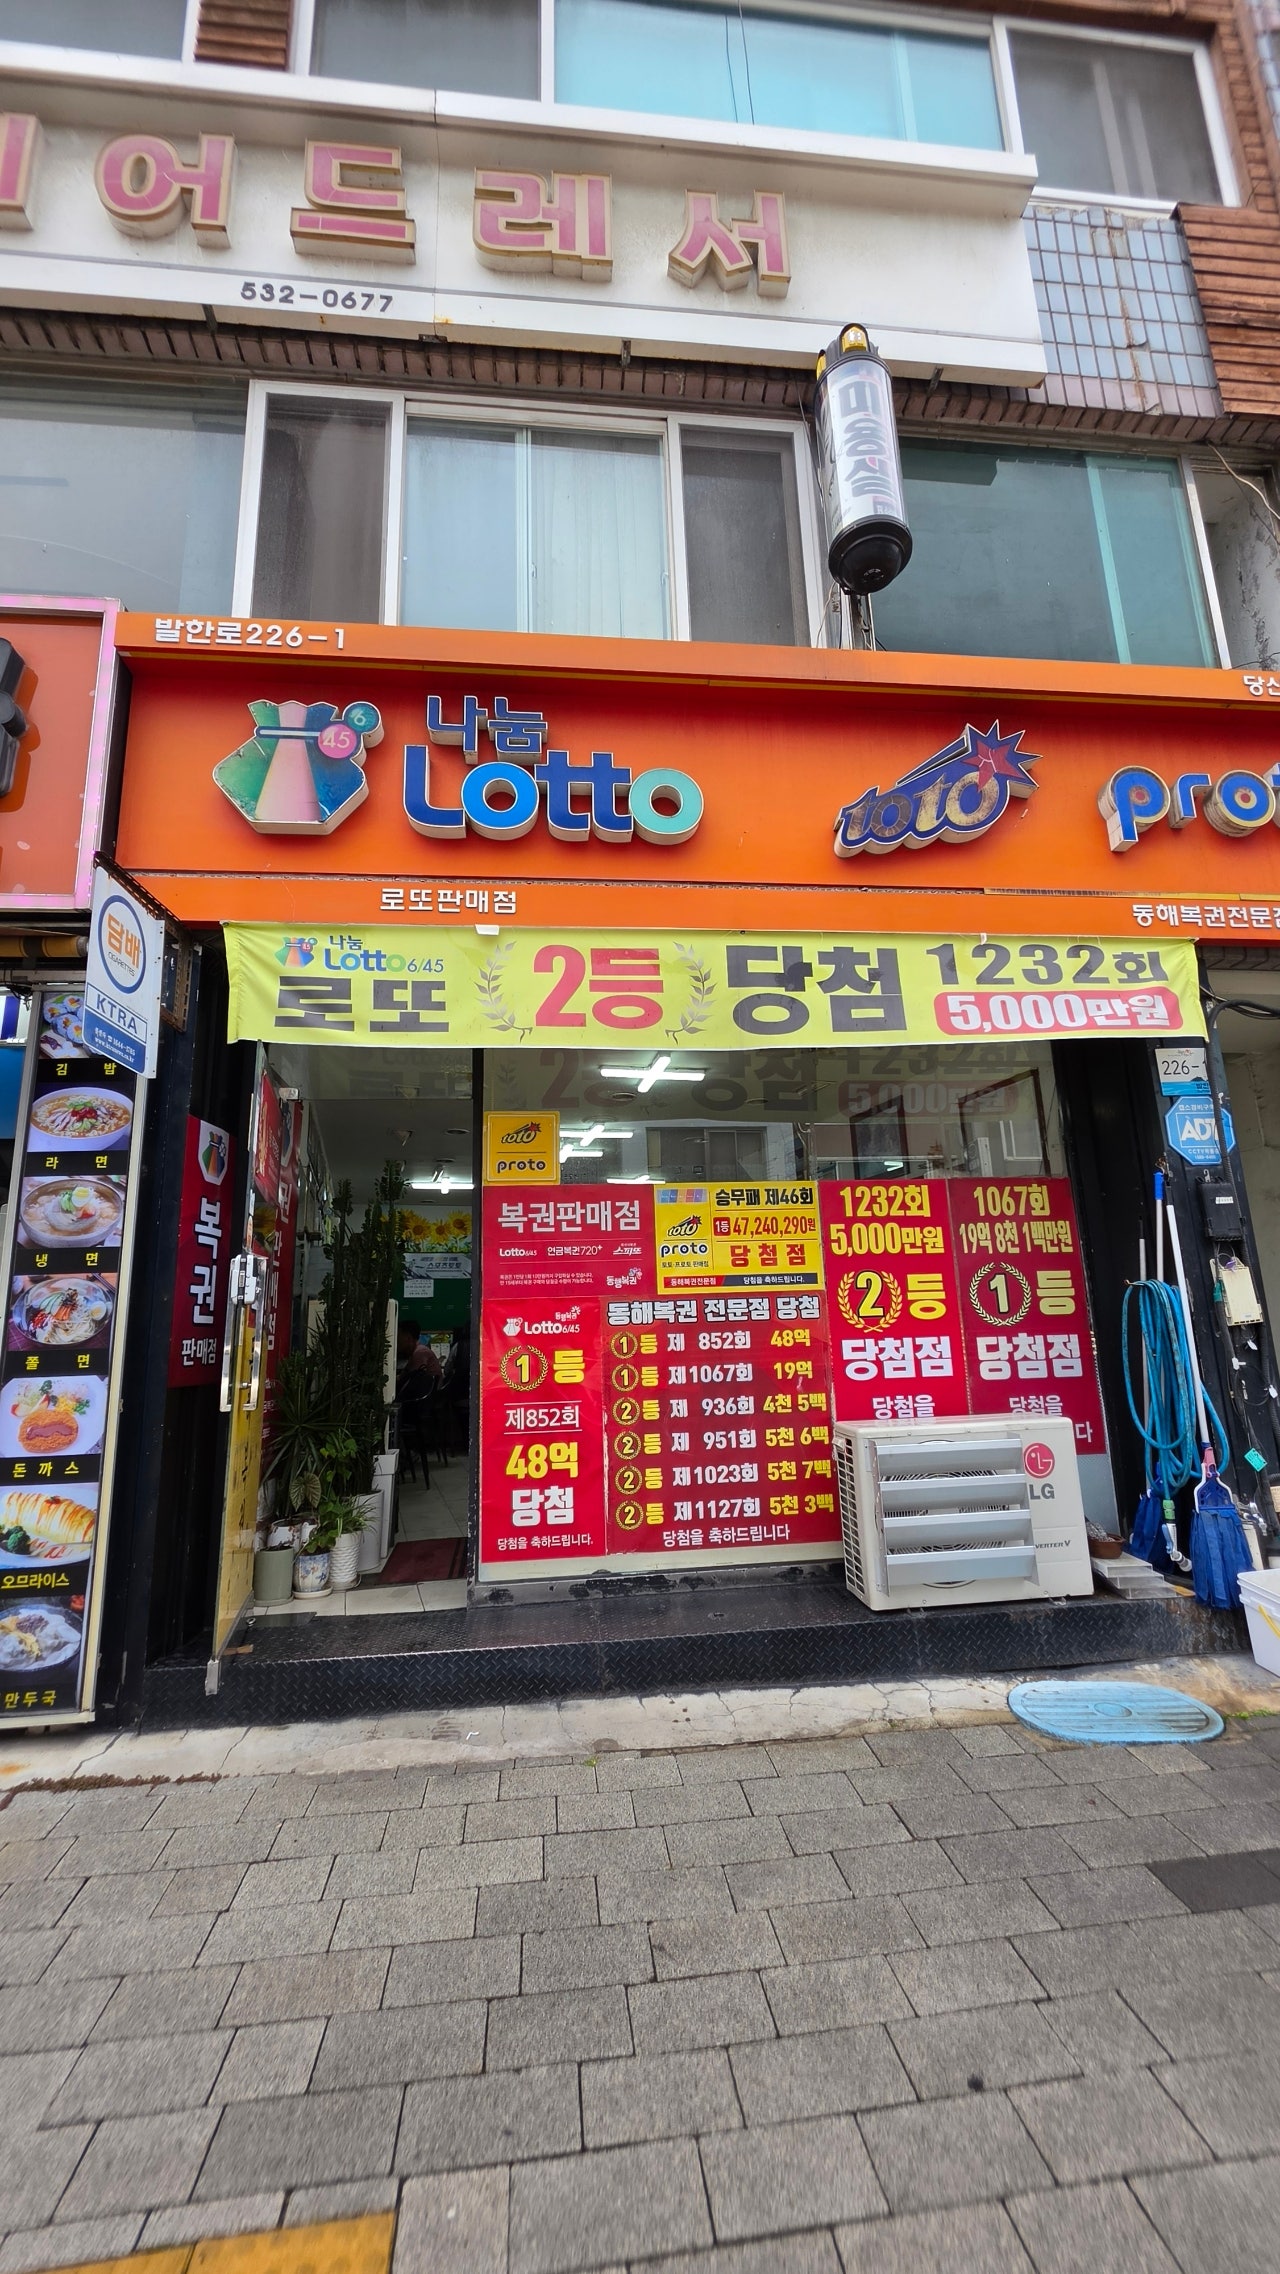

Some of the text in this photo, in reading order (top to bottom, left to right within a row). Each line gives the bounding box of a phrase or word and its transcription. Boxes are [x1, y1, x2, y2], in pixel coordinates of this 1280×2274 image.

[240, 281, 393, 313] 532-0677
[838, 380, 893, 498] 미용실
[322, 731, 351, 749] 45
[426, 695, 548, 758] 나눔
[403, 745, 704, 841] Lotto
[836, 745, 1014, 850] toto
[380, 888, 517, 914] 로또판매점
[107, 913, 140, 968] 담배
[329, 935, 364, 951] 나눔
[533, 943, 1169, 1035] 2등 당첨 1232회
[96, 993, 137, 1034] KTRA
[274, 975, 450, 1033] 로또
[947, 994, 1170, 1032] 5,000만원
[501, 1126, 538, 1144] toto
[1181, 1117, 1219, 1141] ADT
[497, 1158, 546, 1174] proto
[715, 1188, 760, 1207] 승무패
[764, 1187, 814, 1206] 제46회
[839, 1184, 932, 1217] 1232회
[973, 1184, 1051, 1217] 1067회
[497, 1200, 640, 1234] 복권판매점
[667, 1220, 699, 1237] toto
[715, 1216, 817, 1239] 1등 47,240,290원
[660, 1242, 708, 1258] proto
[830, 1222, 945, 1257] 5,000만원
[960, 1220, 1074, 1254] 19억 8천 1백만원
[190, 1197, 222, 1325] 복권
[606, 1274, 637, 1289] 동행복권
[670, 1278, 717, 1286] 동해복권전문점
[743, 1277, 763, 1285] 당첨을
[1036, 1270, 1076, 1316] 등
[906, 1273, 946, 1320] 등
[607, 1295, 820, 1326] 동해복권 전문점 당첨
[182, 1337, 218, 1366] 판매점
[667, 1333, 685, 1351] 제
[698, 1330, 751, 1350] 852회
[770, 1328, 811, 1347] 48억
[553, 1349, 585, 1384] 등
[774, 1361, 813, 1379] 19억
[841, 1335, 954, 1381] 당첨점
[976, 1333, 1083, 1380] 당첨점
[505, 1405, 579, 1430] 제852회
[669, 1399, 688, 1418] 제
[701, 1396, 755, 1416] 936회
[762, 1394, 792, 1413] 4천
[797, 1392, 827, 1412] 5백
[872, 1394, 935, 1419] 당첨을
[671, 1432, 689, 1452] 제
[703, 1429, 757, 1450] 951회
[765, 1427, 794, 1447] 5천
[800, 1426, 830, 1445] 6백
[505, 1442, 578, 1479] 48억
[767, 1461, 797, 1481] 5천
[802, 1459, 832, 1479] 7백
[769, 1495, 799, 1515] 5천
[804, 1493, 835, 1514] 3백
[1028, 1483, 1055, 1500] LG
[512, 1485, 574, 1527] 당첨
[497, 1533, 594, 1551] 당첨을 축하드립니다.
[662, 1523, 790, 1547] 당첨을 축하드립니다
[1, 1572, 70, 1590] 오므라이스
